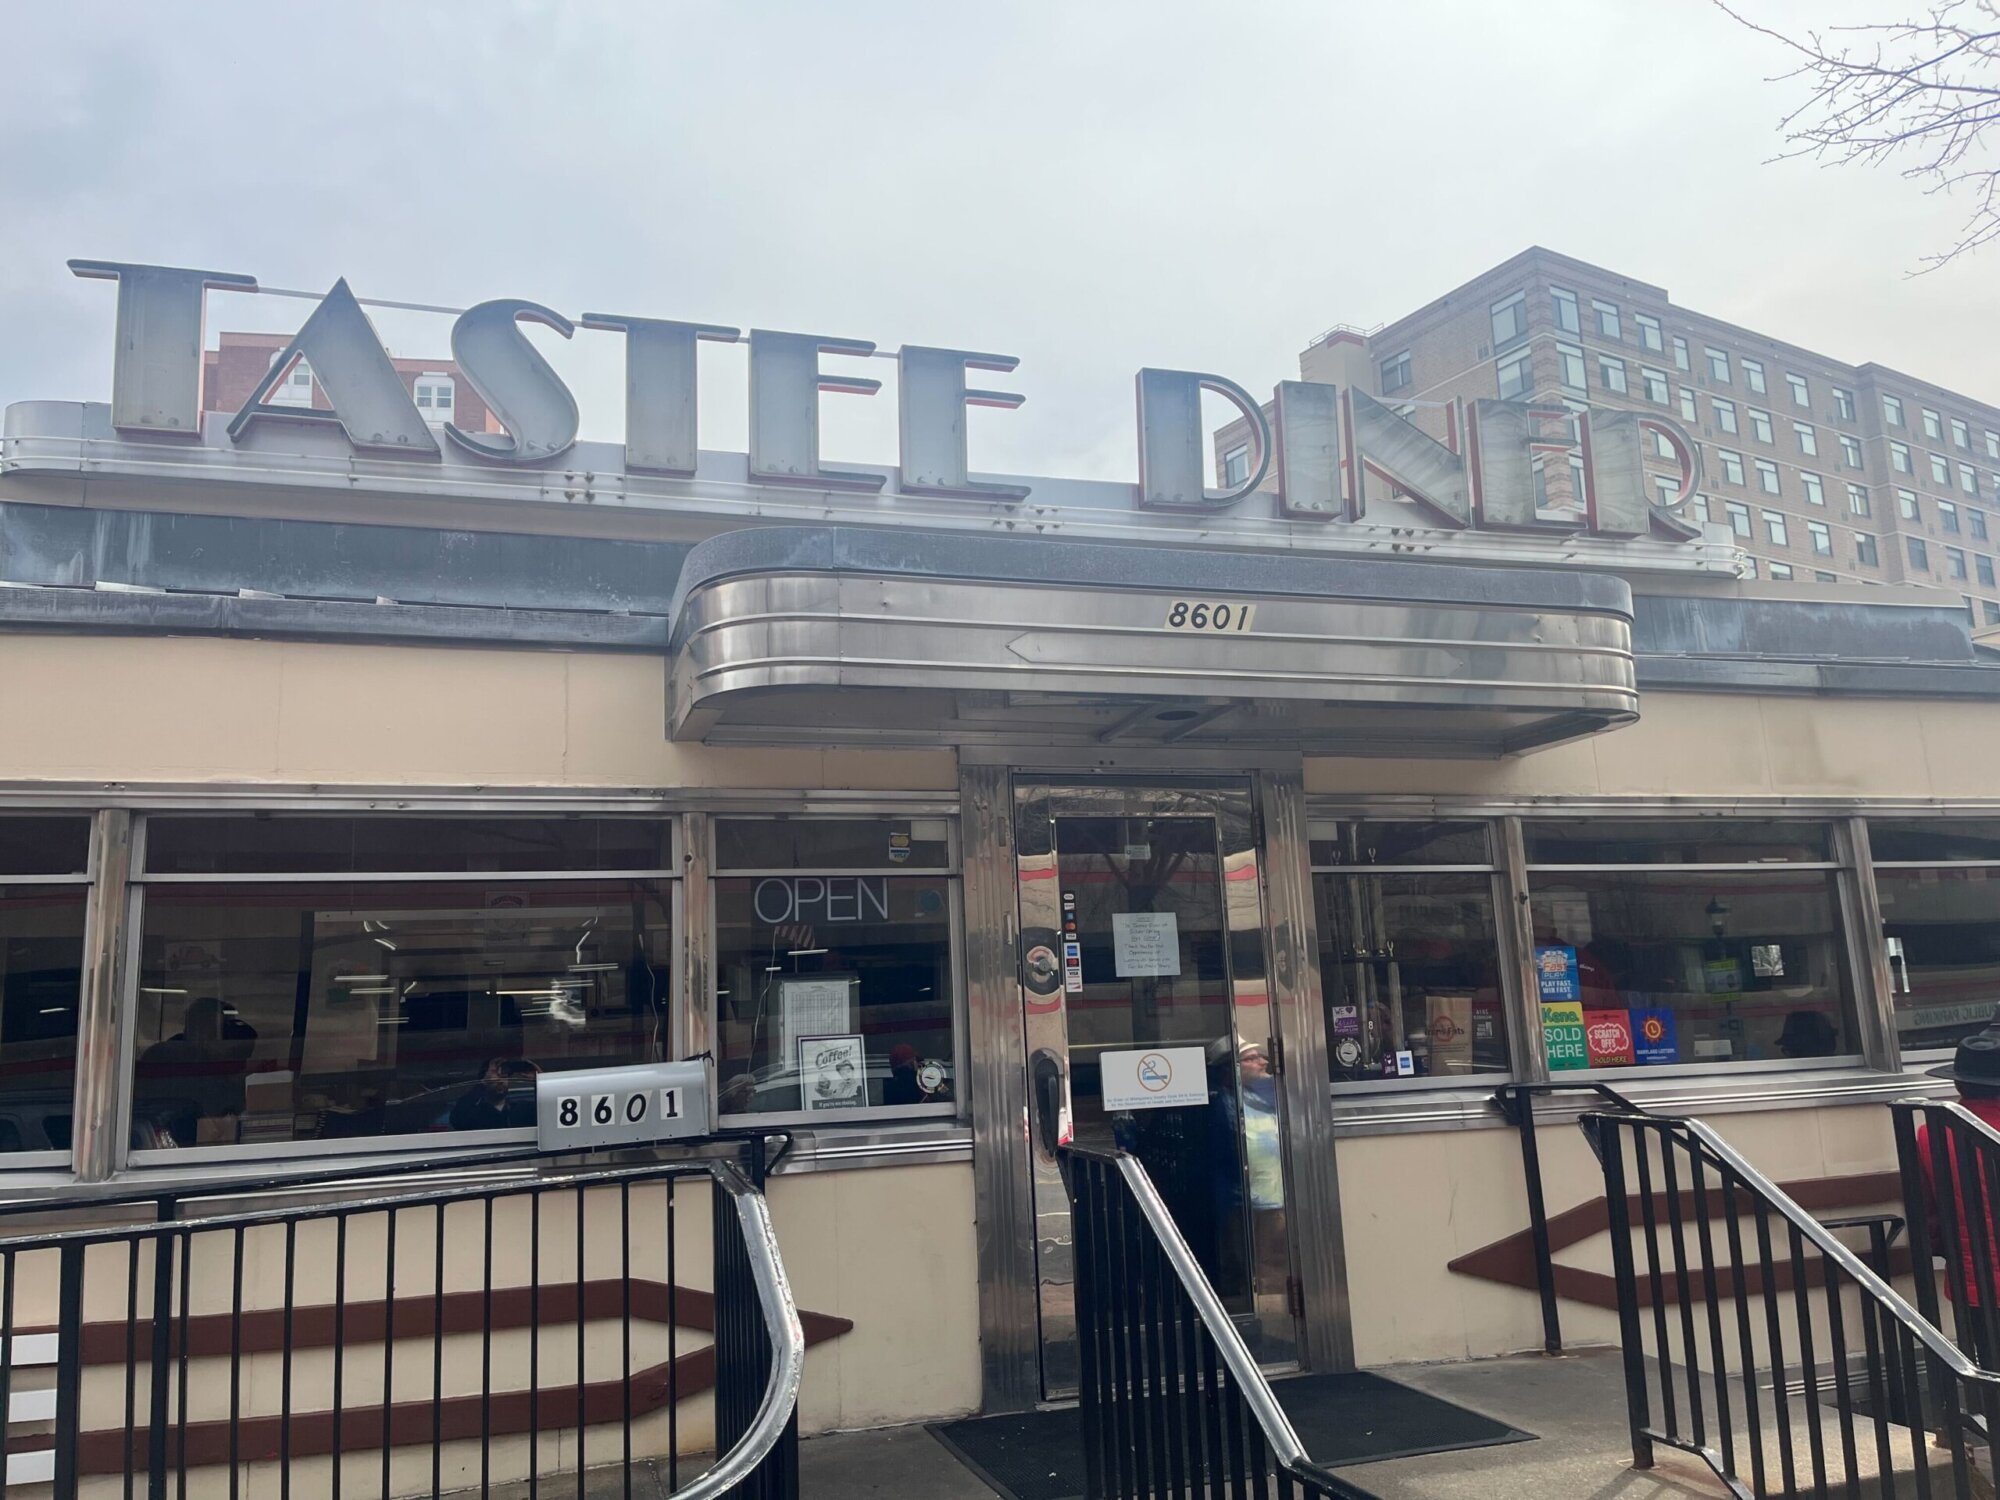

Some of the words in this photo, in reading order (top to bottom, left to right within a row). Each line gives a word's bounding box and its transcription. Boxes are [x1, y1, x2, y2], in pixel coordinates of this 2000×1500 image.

[67, 259, 1030, 503] TASTEE
[1135, 367, 1704, 543] DINER
[1167, 601, 1250, 633] 8601
[754, 877, 889, 924] OPEN
[1543, 1027, 1582, 1042] SOLD
[1594, 1028, 1621, 1039] SCRATCH
[1546, 1043, 1585, 1059] HERE
[1600, 1038, 1617, 1049] OFFS
[816, 1045, 852, 1068] Coffee!
[1594, 1056, 1611, 1064] SOLD
[1611, 1055, 1628, 1063] HERE
[559, 1089, 679, 1126] 8601
